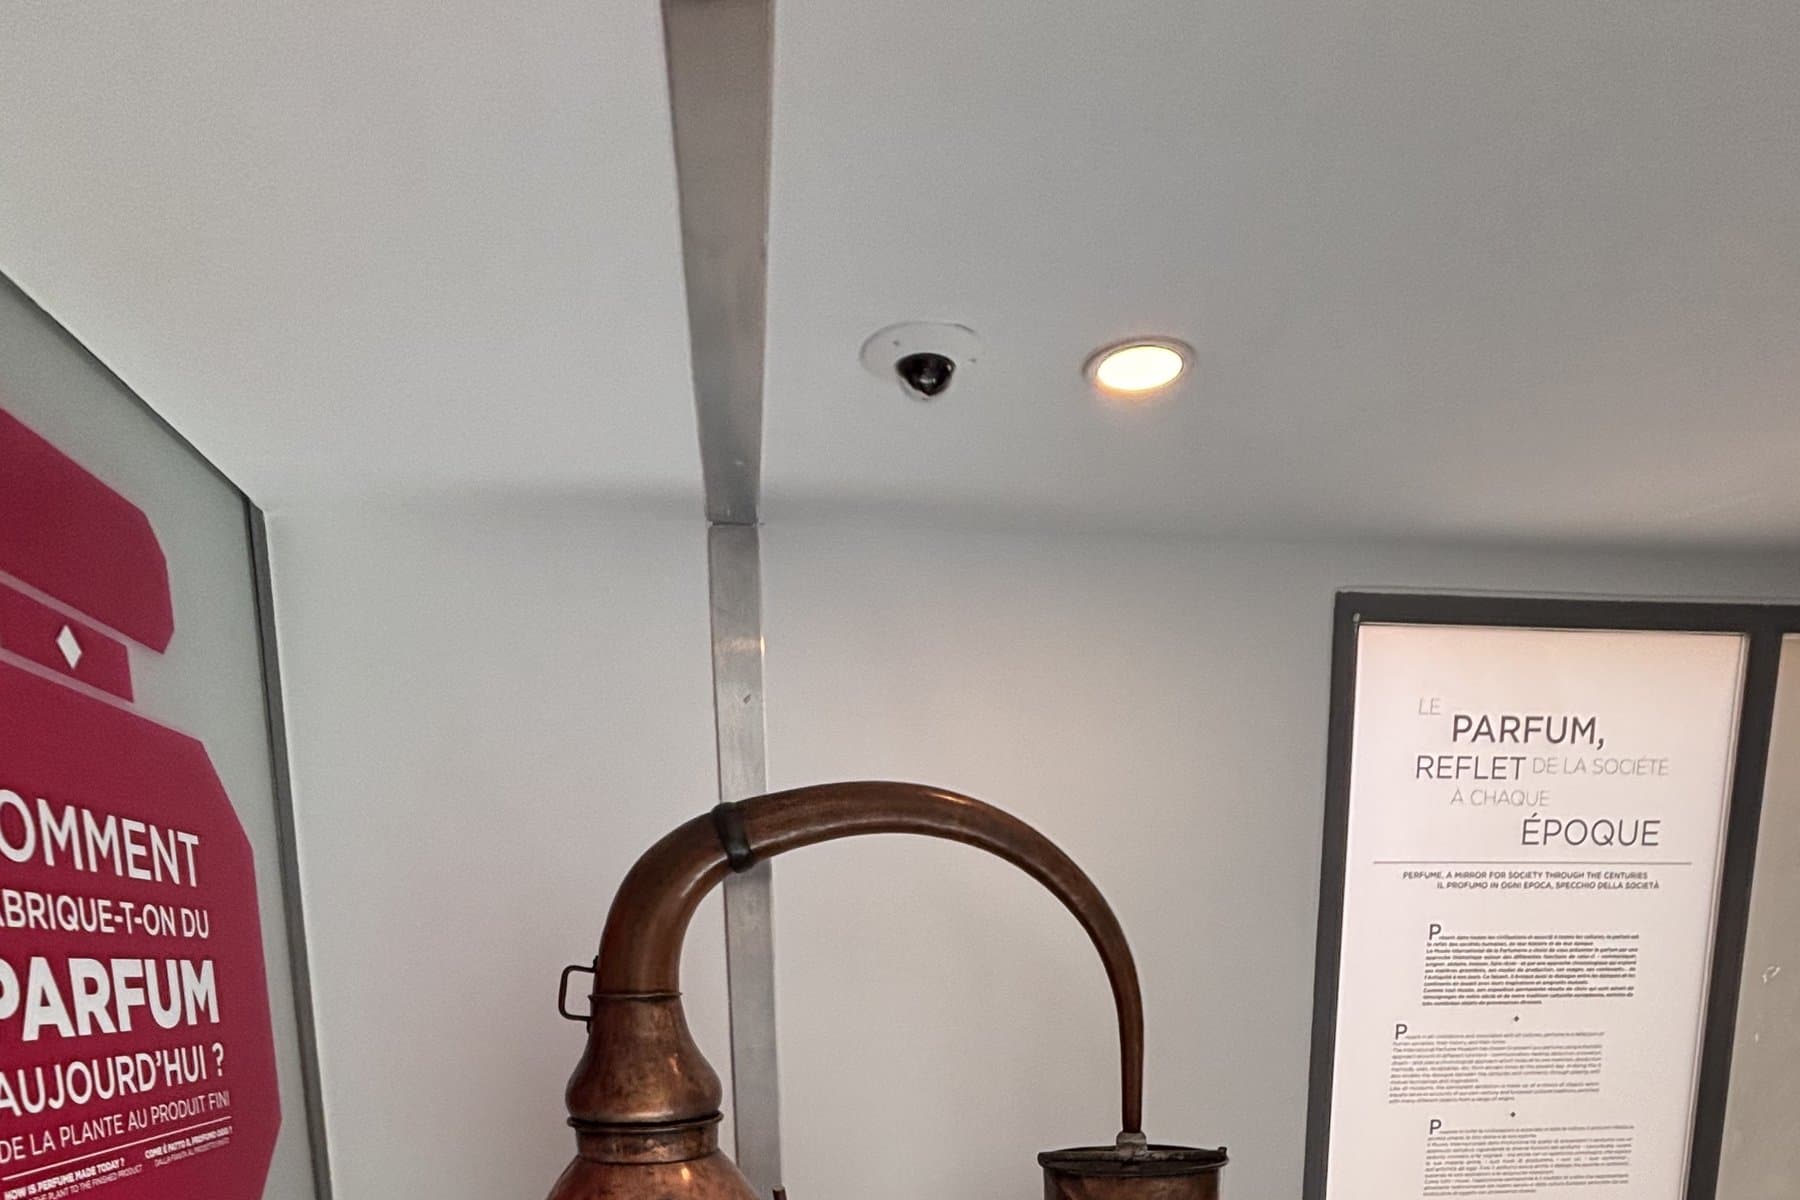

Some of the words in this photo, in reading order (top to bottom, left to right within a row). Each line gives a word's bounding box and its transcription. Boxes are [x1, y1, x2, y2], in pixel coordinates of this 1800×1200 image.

[1417, 697, 1441, 716] LE
[1452, 714, 1605, 750] PARFUM,
[1415, 755, 1526, 780] REFLET
[1532, 757, 1560, 775] DE
[1563, 757, 1586, 775] LA
[1470, 788, 1550, 808] CHAQUE
[1521, 812, 1661, 846] ÉPOQUE
[1489, 871, 1506, 879] FOR
[1508, 871, 1543, 879] SOCIETY
[1587, 871, 1601, 879] THE
[0, 888, 177, 937] BRIQUE-T-ON
[180, 907, 209, 939] DU
[0, 1044, 207, 1117] AUJOURD’HUI
[212, 1042, 225, 1077] ?
[0, 1136, 26, 1164] DE
[30, 1130, 56, 1155] LA
[59, 1113, 125, 1147] PLANTE
[128, 1108, 147, 1131] AU
[150, 1096, 206, 1125] PRODUIT
[208, 1090, 230, 1110] FINI
